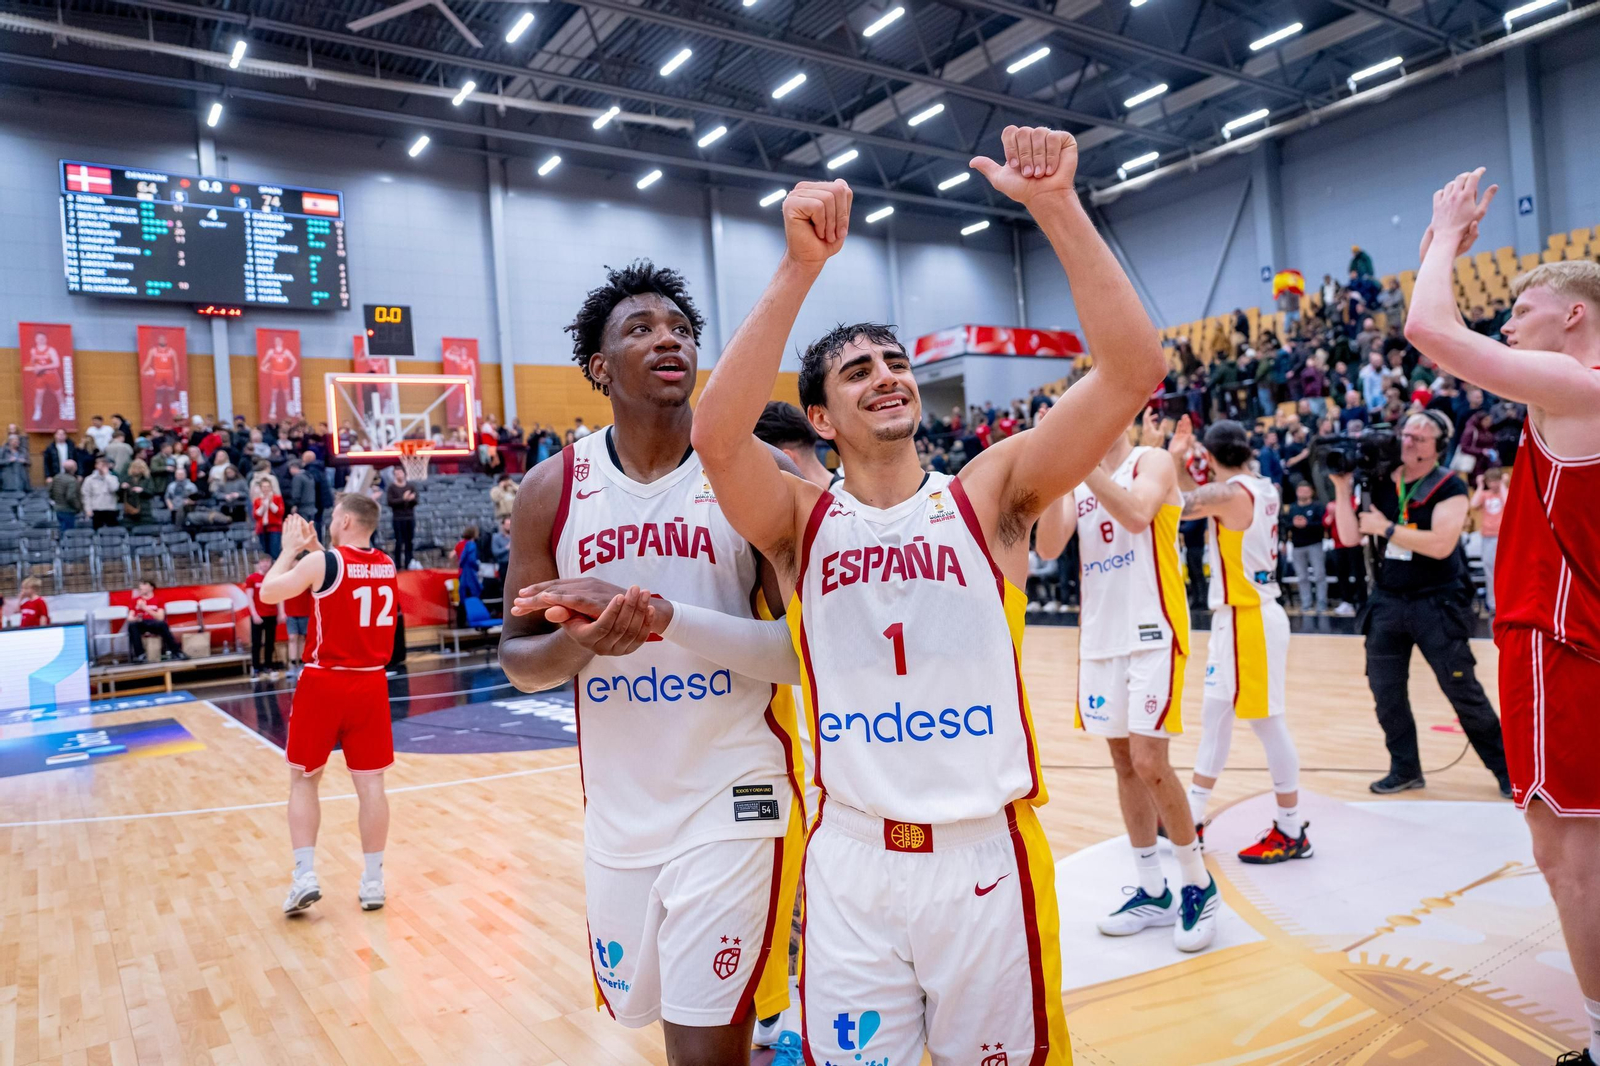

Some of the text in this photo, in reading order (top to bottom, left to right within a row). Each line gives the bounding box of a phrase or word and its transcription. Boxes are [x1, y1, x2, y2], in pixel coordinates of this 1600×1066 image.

[198, 179, 222, 193] 0.0
[261, 194, 281, 207] 74
[374, 306, 402, 323] 0.0
[578, 516, 717, 574] ESPAÑA
[1099, 520, 1114, 543] 8
[821, 535, 967, 595] ESPAÑA
[352, 585, 394, 628] 12
[883, 622, 907, 676] 1
[586, 666, 731, 703] endesa
[819, 702, 994, 743] endesa
[761, 805, 771, 814] 54
